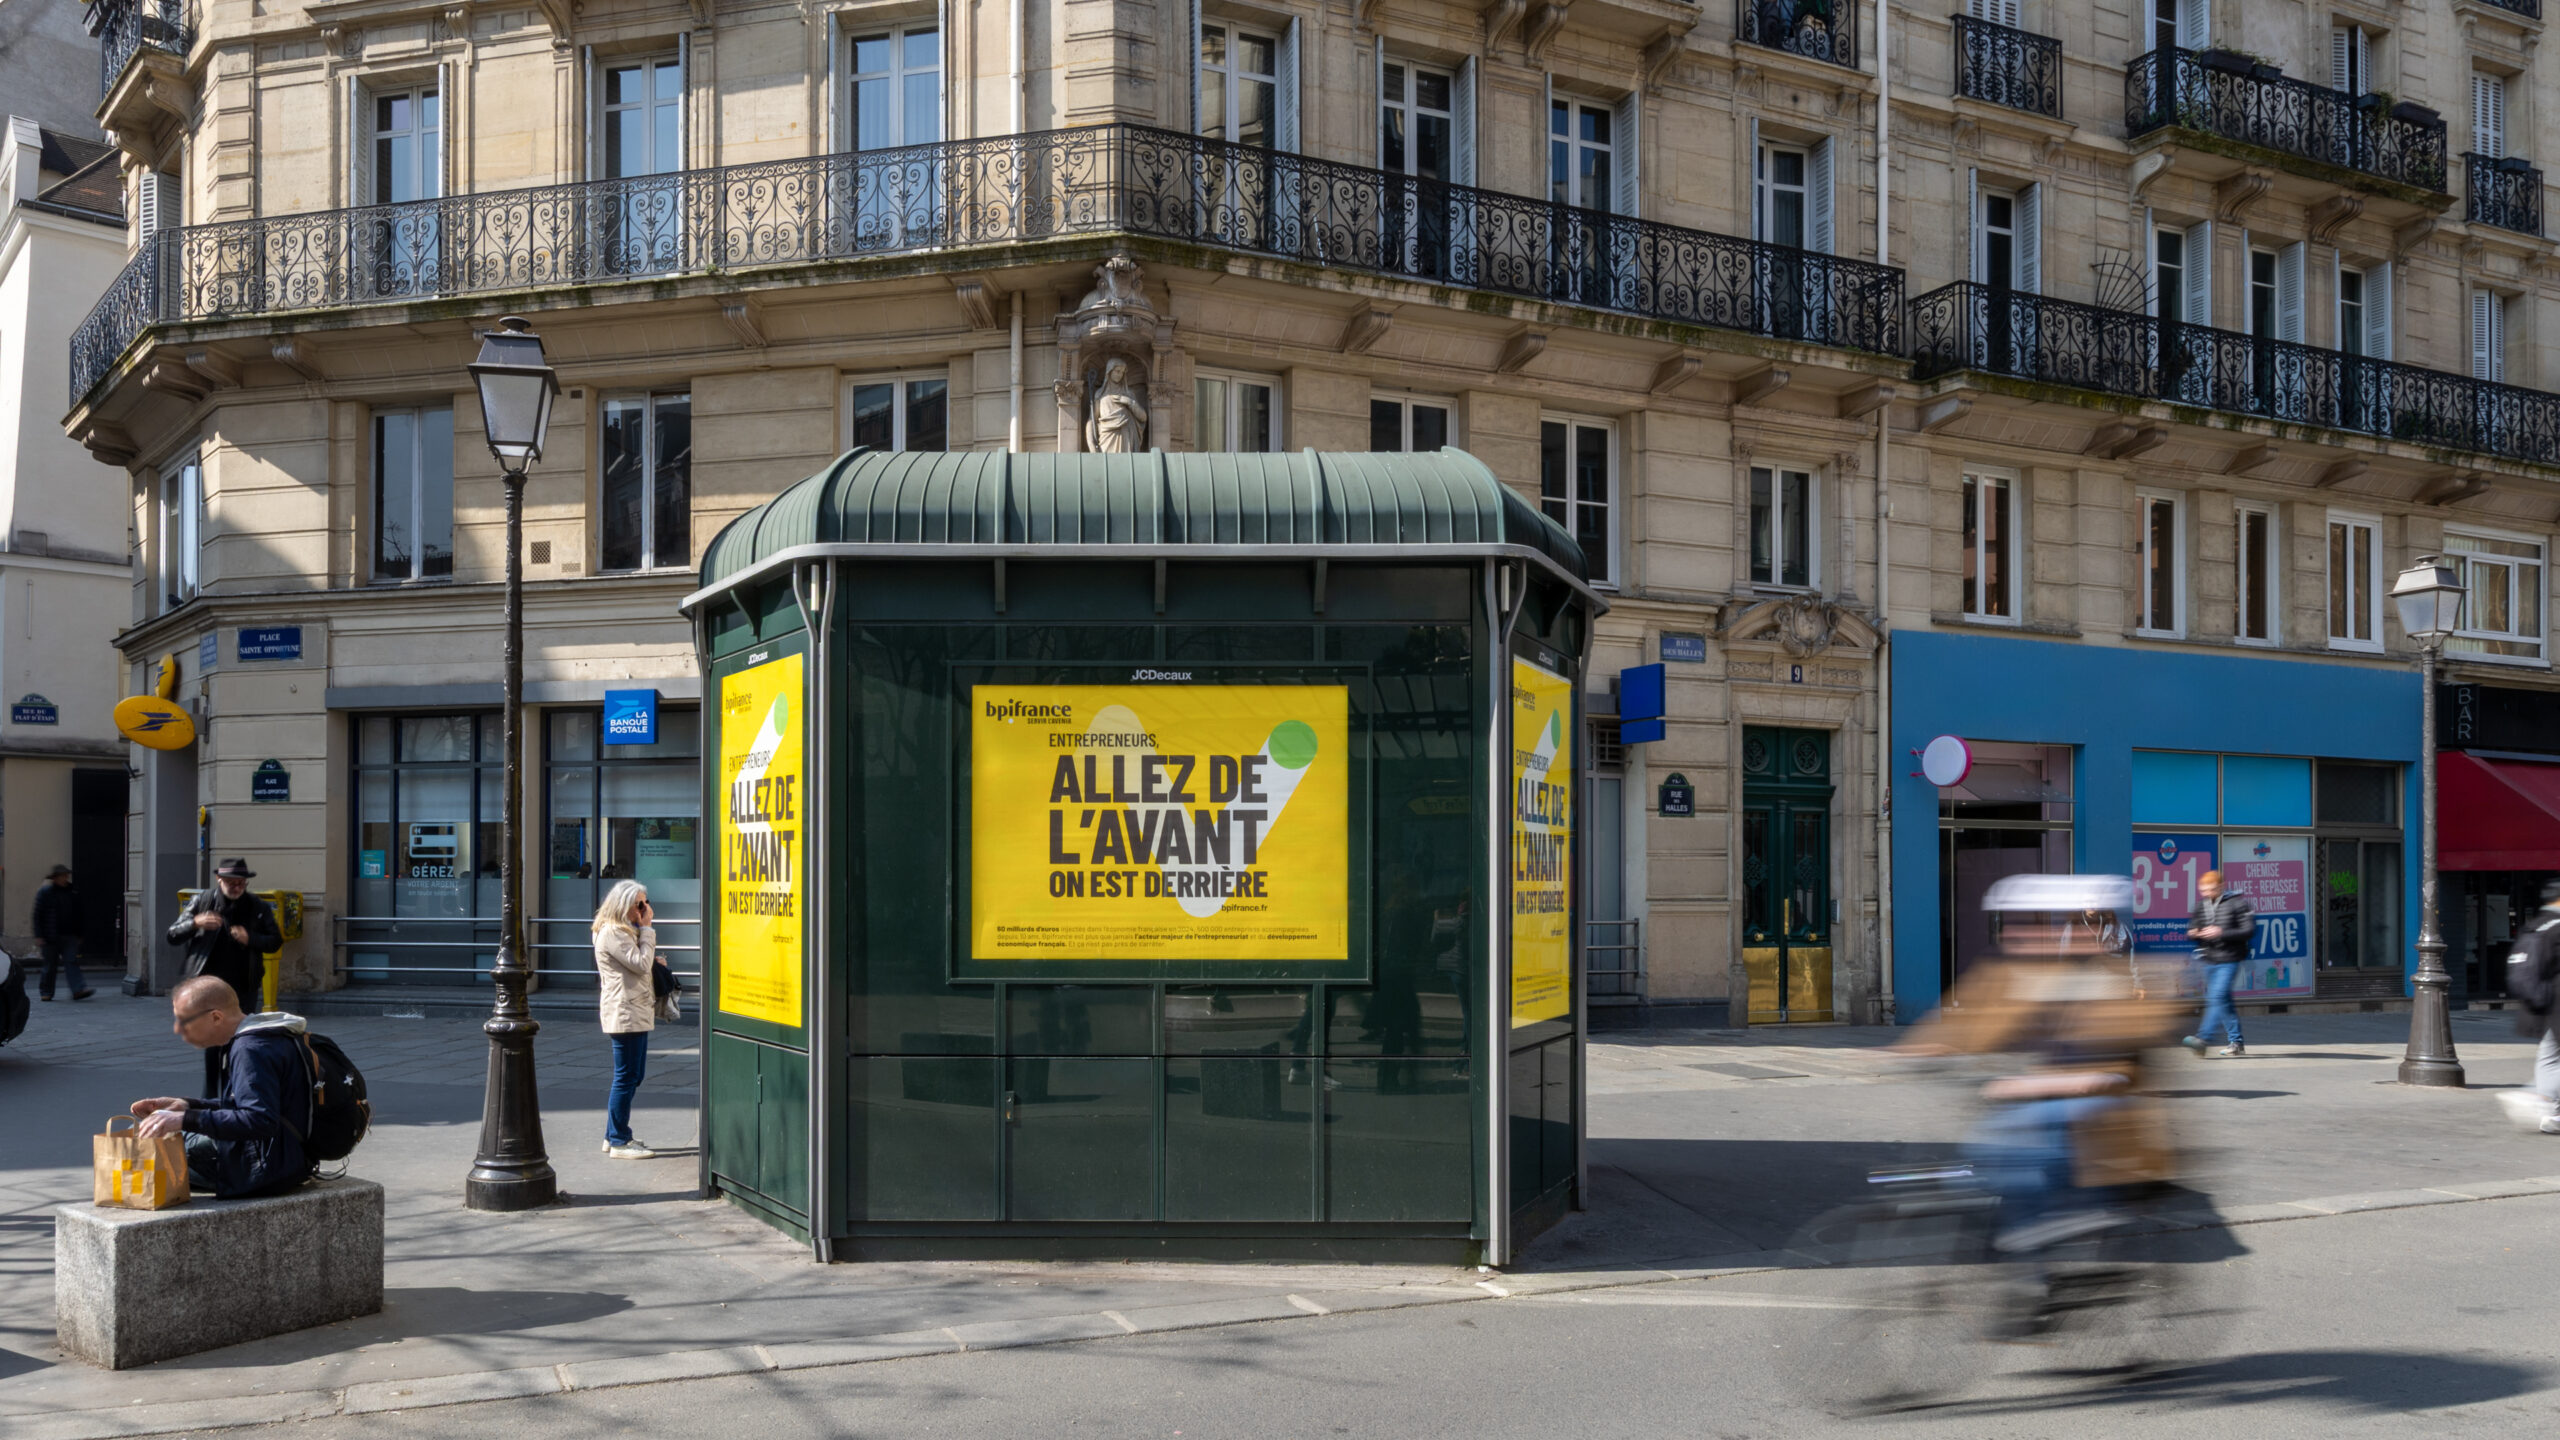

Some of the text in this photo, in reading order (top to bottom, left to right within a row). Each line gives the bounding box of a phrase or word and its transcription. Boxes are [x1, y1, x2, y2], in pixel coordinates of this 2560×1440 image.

[259, 633, 281, 642] PLACE
[240, 644, 300, 655] SAINTE OPPORTUNE
[1677, 648, 1703, 656] HALLES
[1132, 669, 1192, 680] JCDecaux
[1794, 666, 1800, 681] 9
[986, 699, 1072, 721] bpifrance
[2458, 687, 2472, 739] BAR
[610, 726, 648, 734] POSTALE
[1049, 733, 1159, 749] ENTREPRENEURS,
[1049, 755, 1268, 803] ALLEZ DE
[729, 774, 795, 824] ALLEZ DE
[1670, 790, 1683, 798] RUE
[1516, 777, 1565, 827] ALLEZ DE
[1665, 804, 1688, 812] HALLES
[1049, 809, 1268, 865] L'AVANT
[728, 830, 795, 882] L'AVANT
[1517, 831, 1564, 881] L'AVANT
[412, 862, 455, 878] GÉREZ
[2245, 863, 2280, 878] CHEMISE
[407, 880, 459, 889] VOTRE ARGENT
[1049, 865, 1268, 897] ON EST DERRIÈRE
[2260, 879, 2299, 894] REPASSEE
[728, 886, 794, 917] ON EST DERRIÈRE
[1221, 904, 1268, 913] bpifrance.fr
[1516, 891, 1525, 915] ON
[1526, 891, 1537, 914] EST
[2260, 896, 2287, 911] CINTRE
[2136, 922, 2165, 932] produits
[997, 940, 1037, 948] économique
[1161, 933, 1184, 941] majeur
